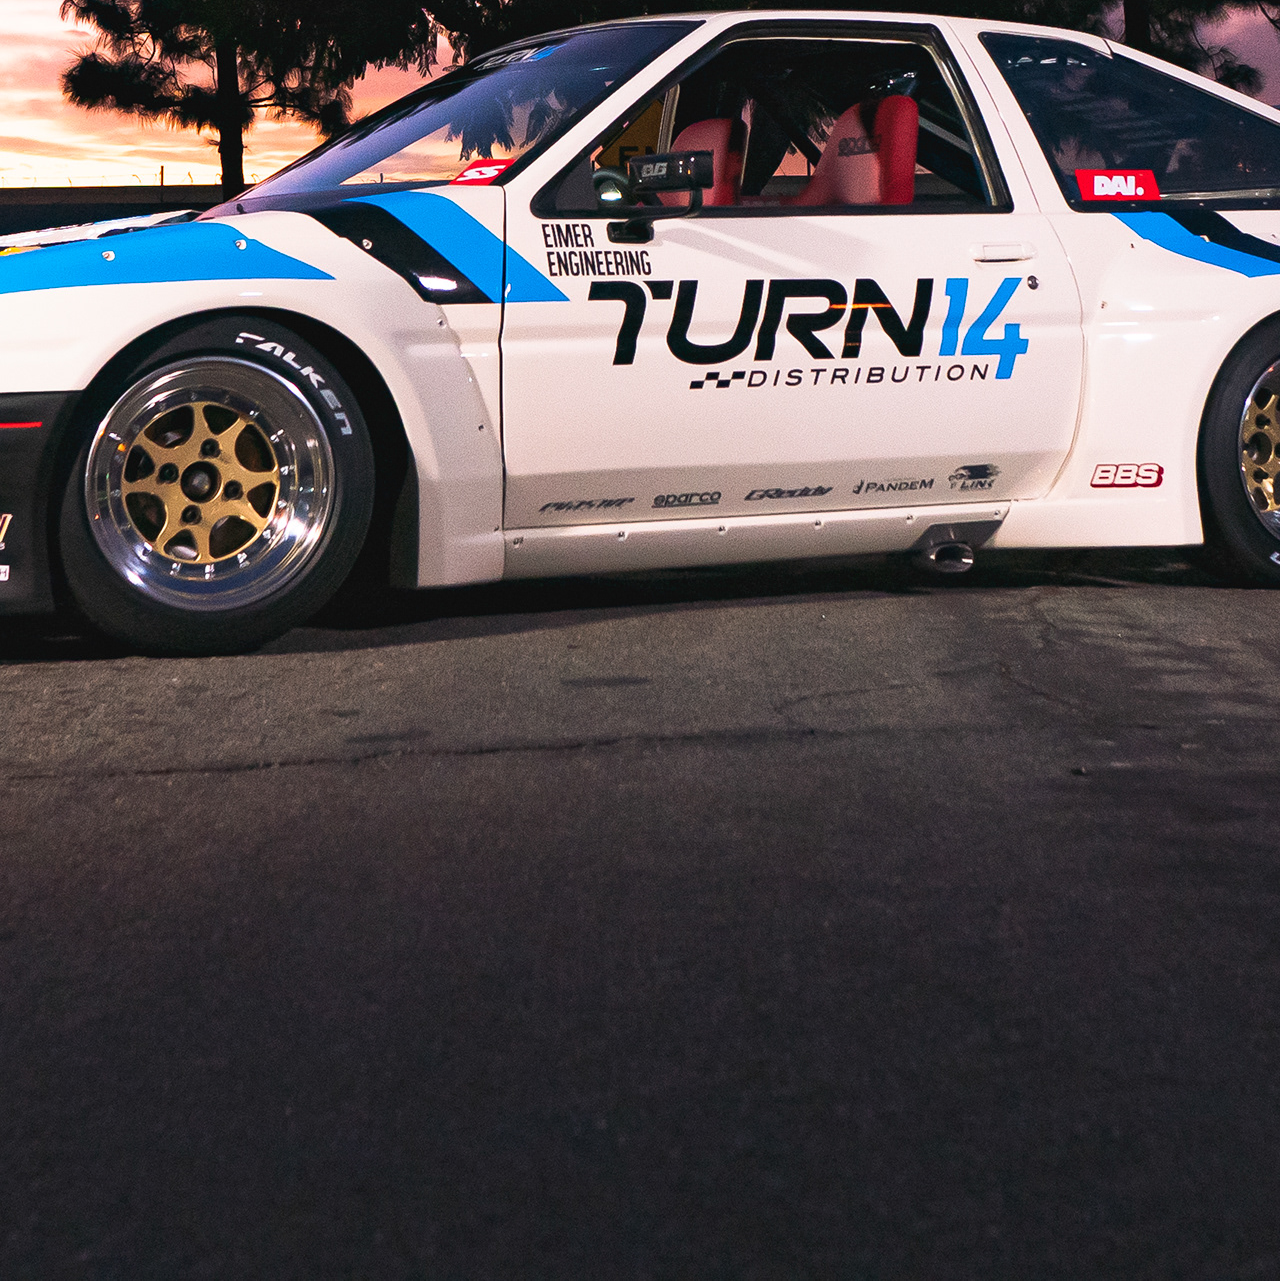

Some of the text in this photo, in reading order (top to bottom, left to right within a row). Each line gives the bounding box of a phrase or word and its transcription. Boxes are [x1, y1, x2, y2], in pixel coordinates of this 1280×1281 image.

[542, 223, 595, 248] EIMER
[546, 250, 652, 276] ENGINEERING
[235, 332, 353, 435] FALKEN
[747, 364, 988, 387] DISTRIBUTION
[865, 479, 935, 493] PANDEM
[1090, 462, 1165, 488] BBS
